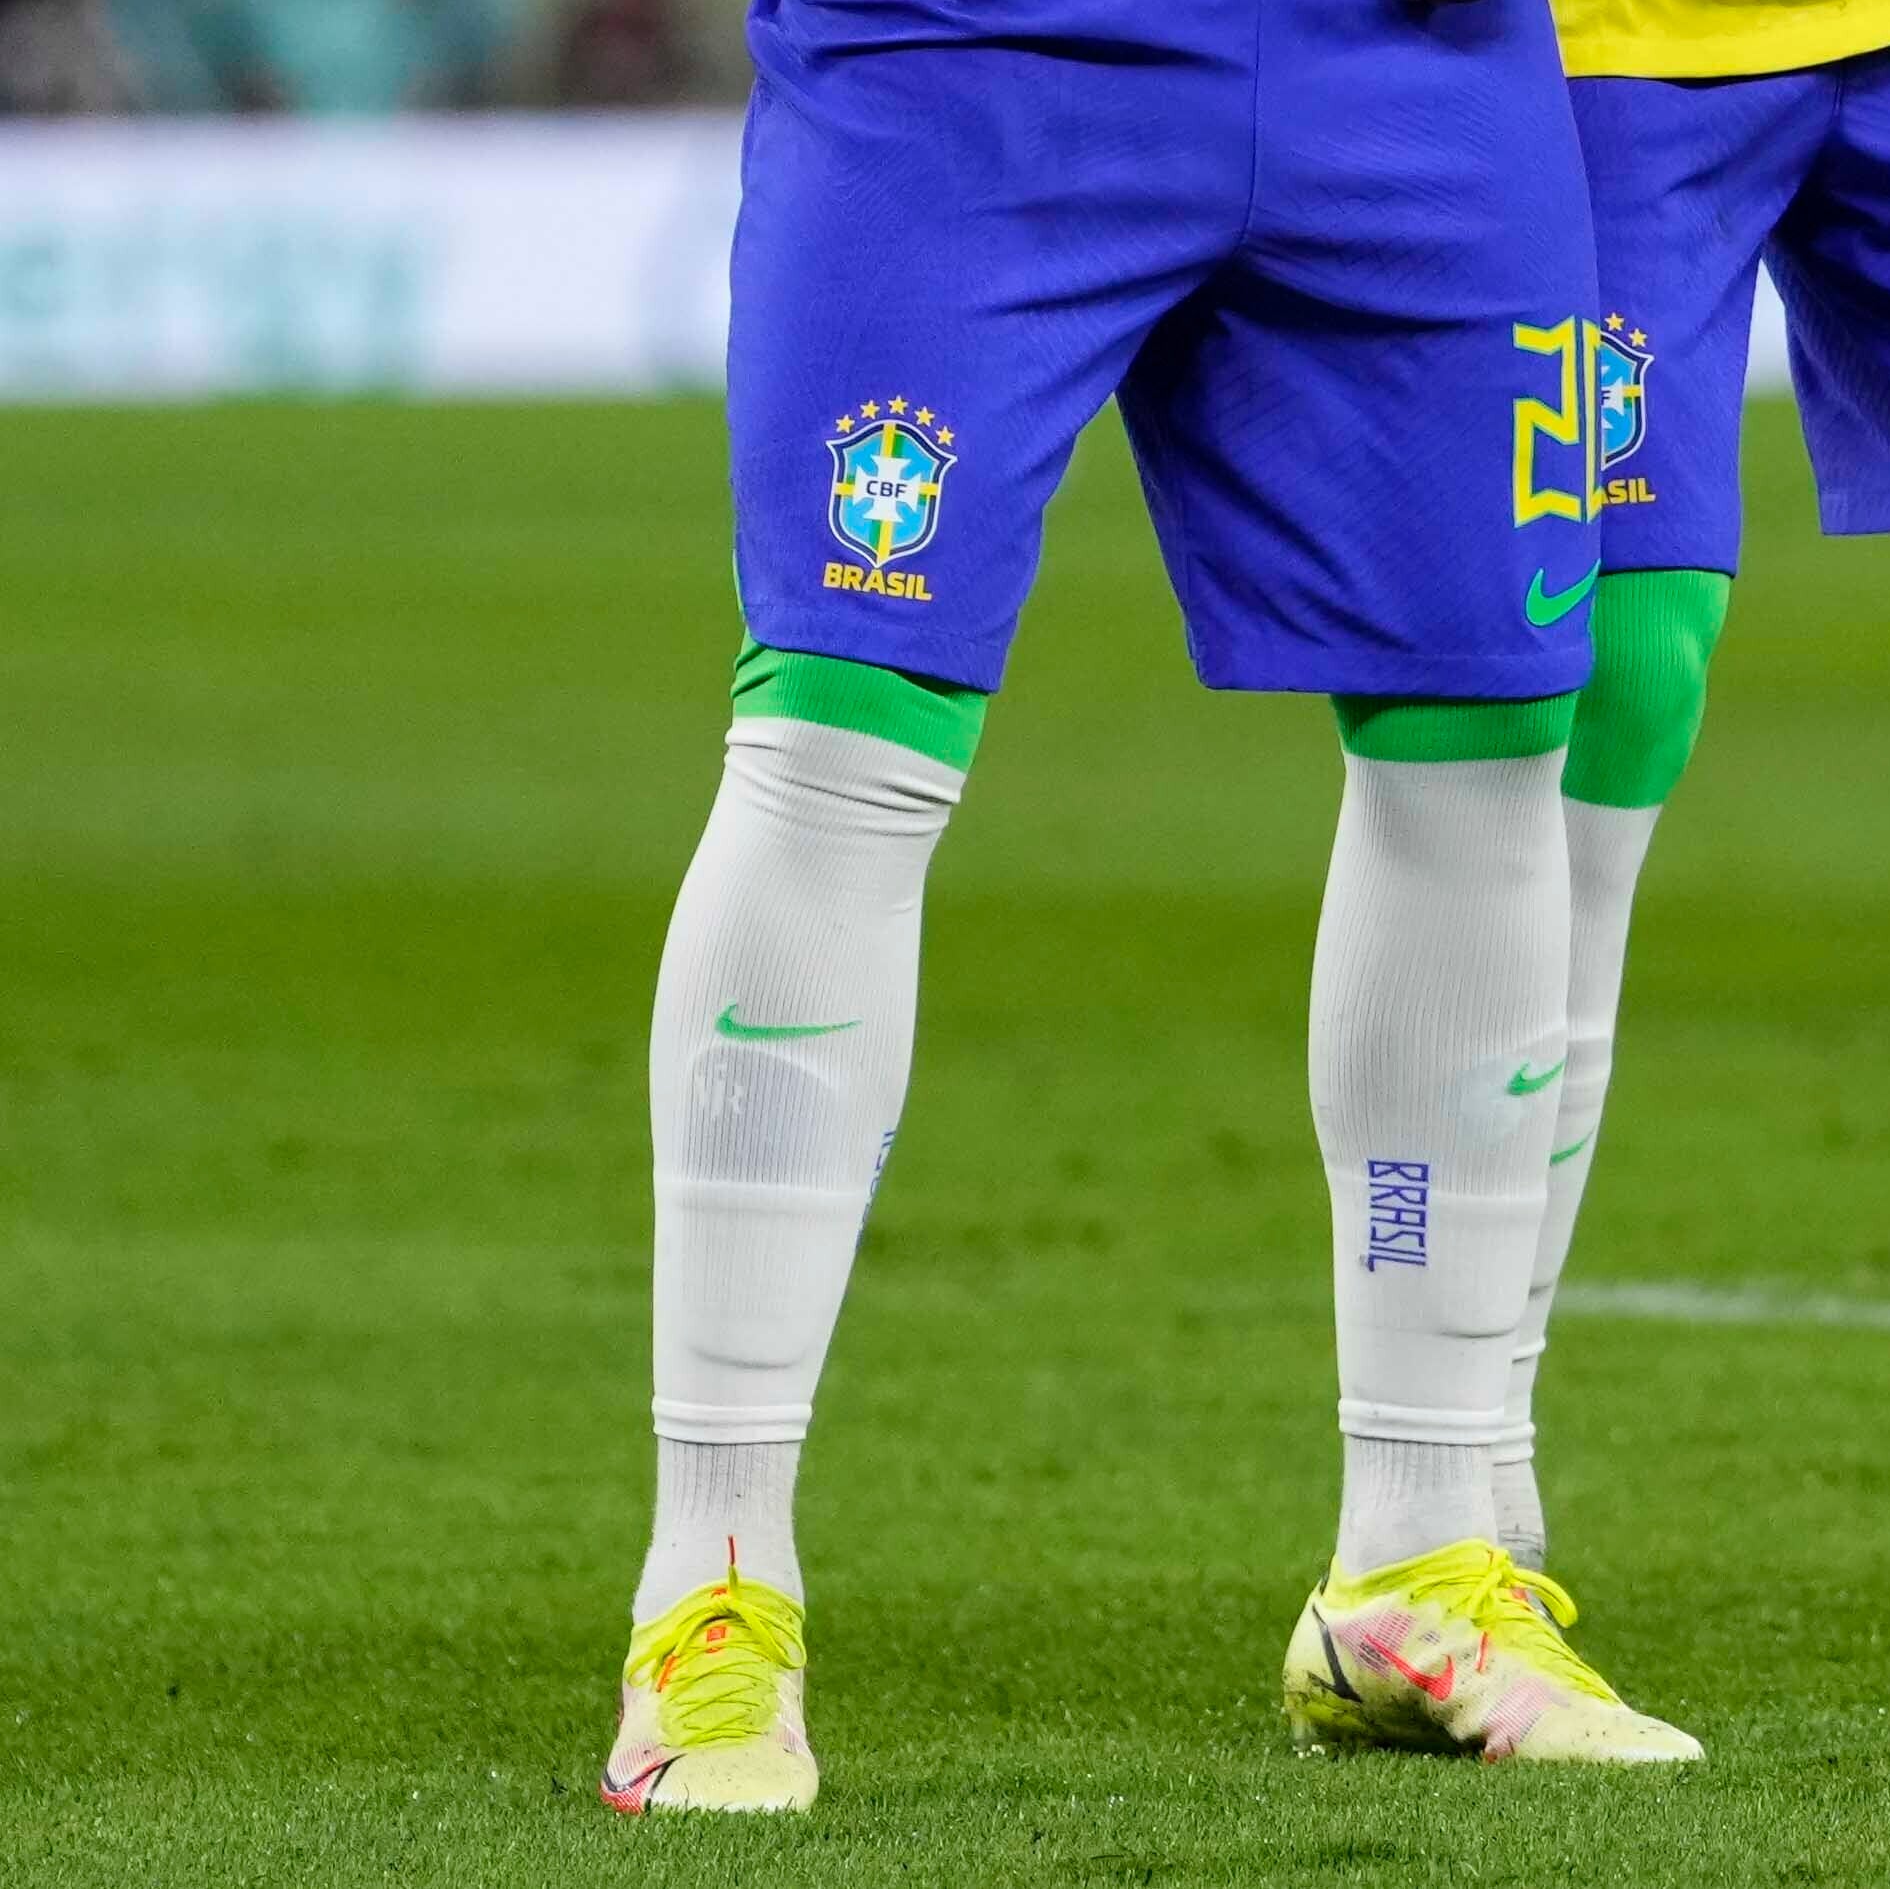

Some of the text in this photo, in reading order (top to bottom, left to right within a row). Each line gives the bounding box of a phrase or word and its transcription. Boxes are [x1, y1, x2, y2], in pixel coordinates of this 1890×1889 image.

[866, 480, 908, 499] CBF
[1600, 476, 1657, 507] SIL
[822, 561, 933, 601] BRASIL
[1365, 1159, 1430, 1272] BRASIL
